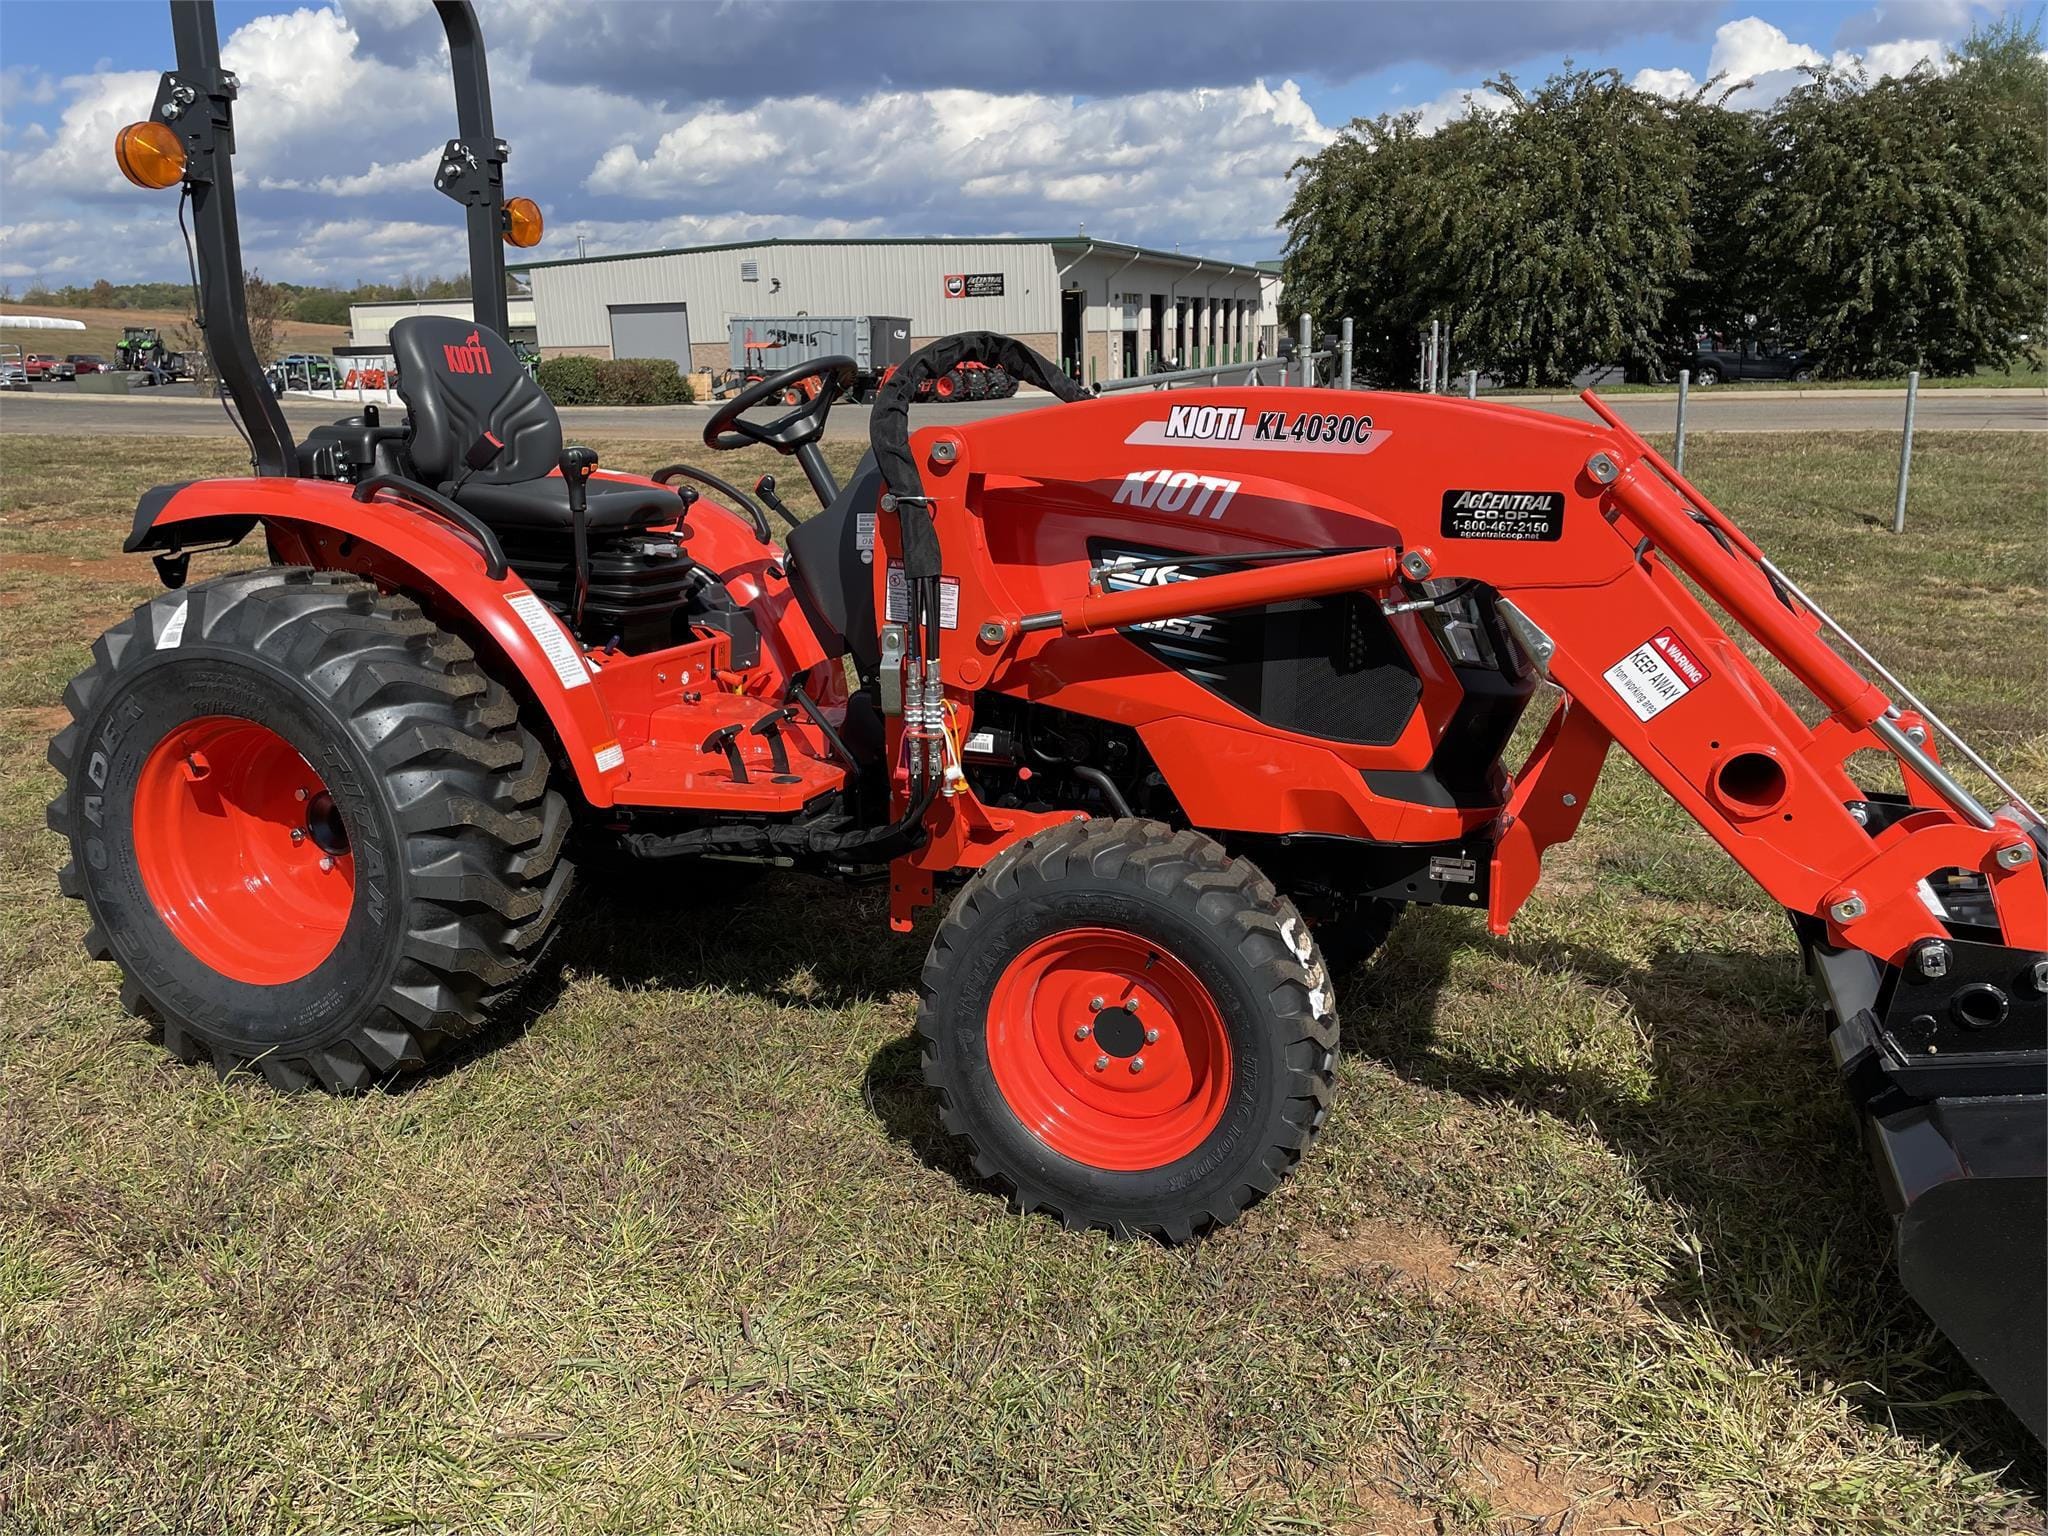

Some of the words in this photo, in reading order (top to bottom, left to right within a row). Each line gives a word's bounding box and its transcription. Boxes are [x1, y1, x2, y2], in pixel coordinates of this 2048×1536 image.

[443, 344, 492, 374] KIOTI
[1165, 405, 1247, 440] KIOTI
[1252, 412, 1374, 444] KL4030C
[1112, 470, 1243, 520] KIOTI
[1453, 491, 1552, 511] AGCENTRAL
[1474, 510, 1529, 520] CO-OP
[1452, 520, 1549, 533] 1-800-467-2150
[1460, 530, 1540, 540] agcentralcoop.net
[1629, 649, 1658, 675] KEEP
[1648, 672, 1681, 701] AWAY
[1666, 643, 1703, 683] WARNING
[1613, 664, 1629, 681] from
[1623, 678, 1645, 704] working
[1641, 699, 1657, 715] area
[322, 743, 386, 927] TITAN
[957, 933, 1011, 1019] TITAN
[1167, 1123, 1242, 1193] LOADER
